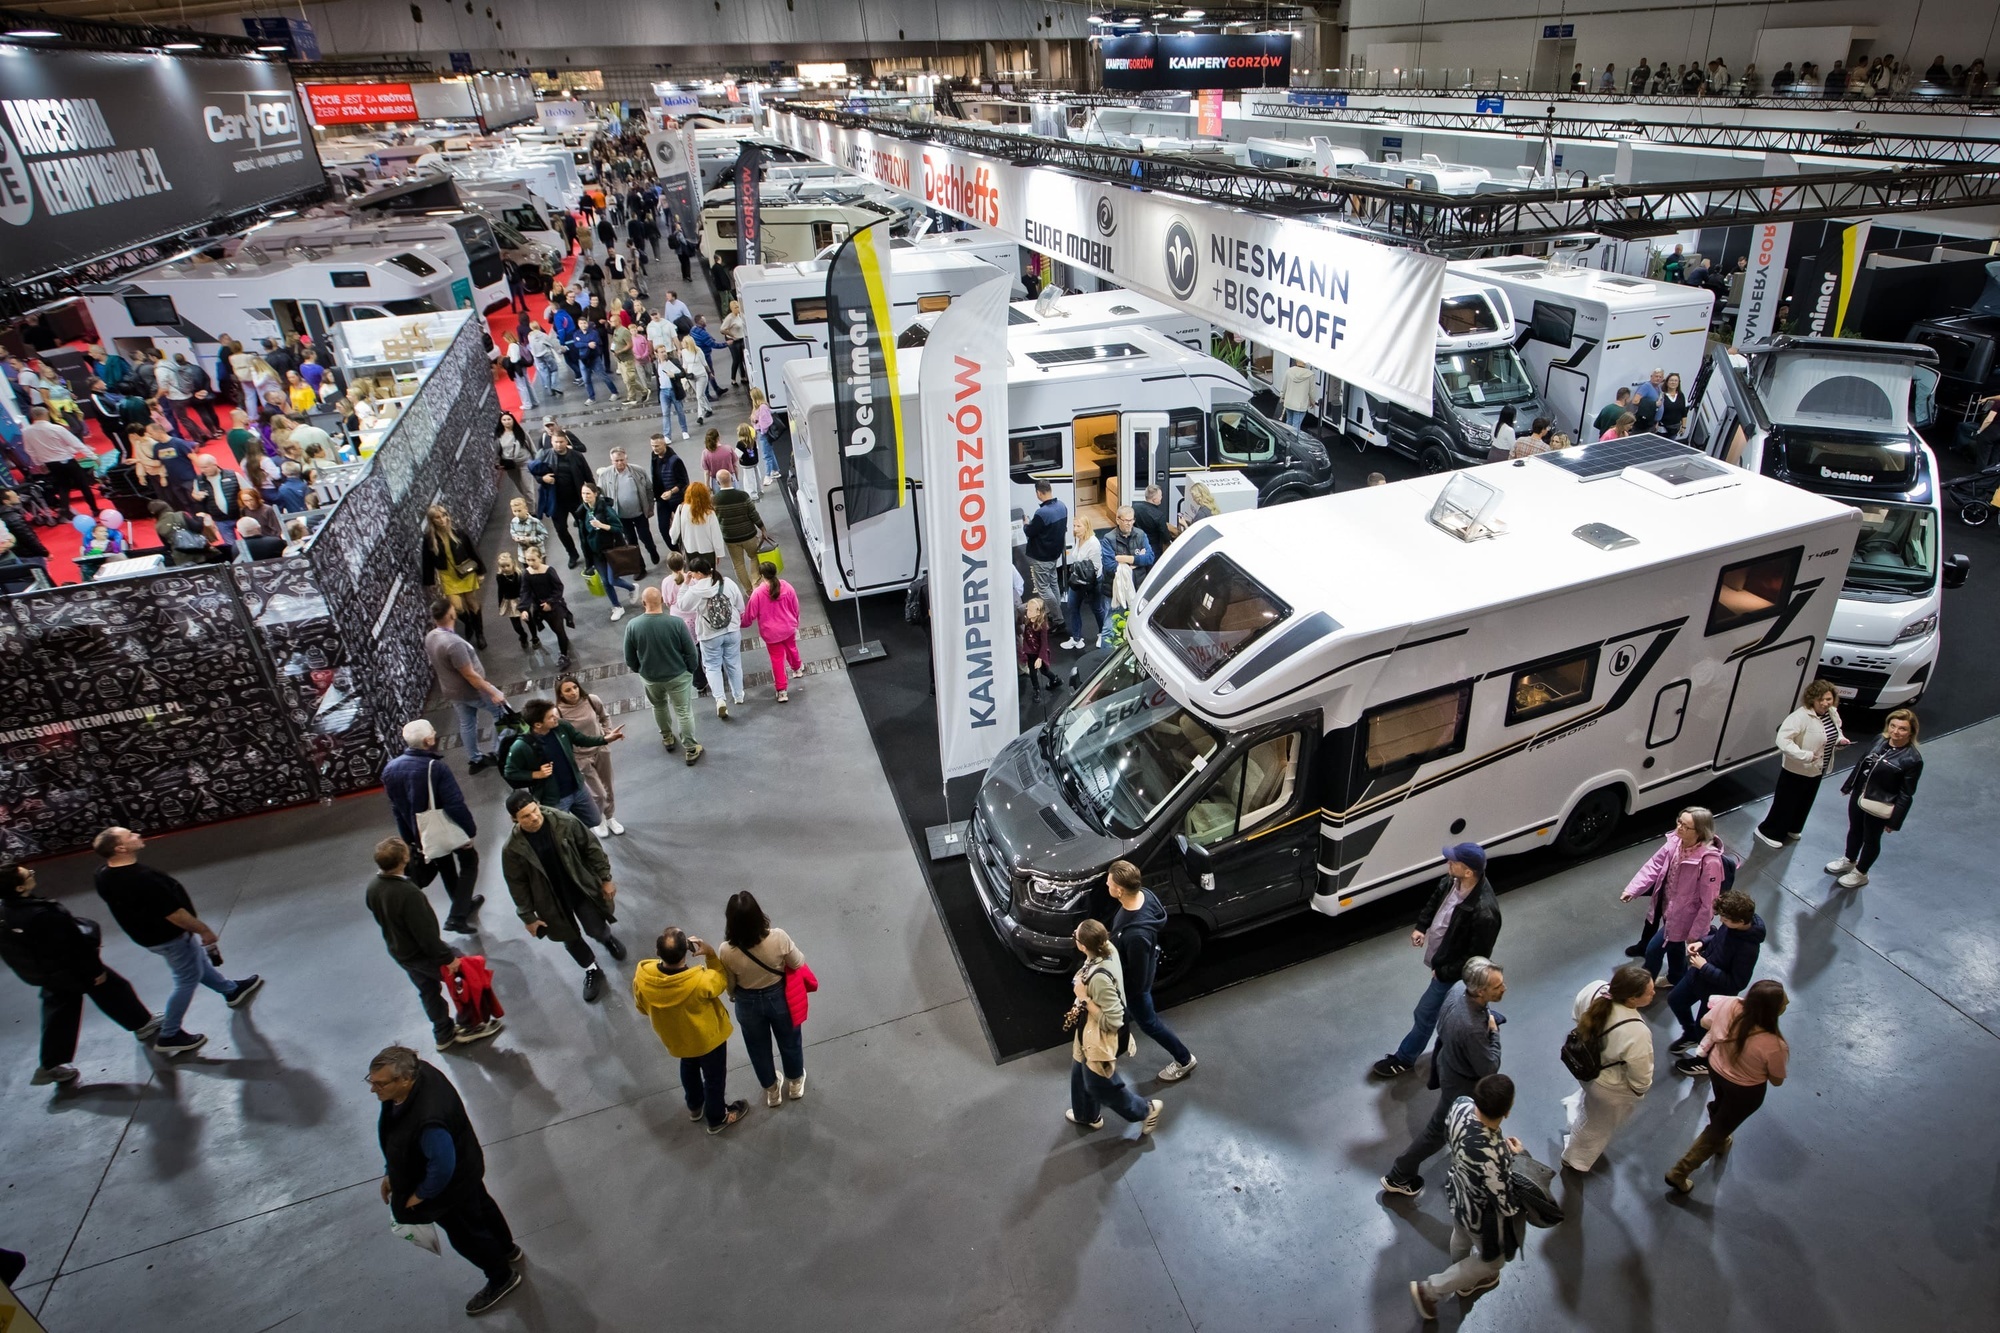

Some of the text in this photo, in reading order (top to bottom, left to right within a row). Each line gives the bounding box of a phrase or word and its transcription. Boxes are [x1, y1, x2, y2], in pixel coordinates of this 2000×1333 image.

[1105, 55, 1154, 70] KAMPERYGORZÓW
[1169, 53, 1282, 69] KAMPERYGORZÓW
[311, 92, 413, 105] ŻYCIE JEST ZA KRÓTKIE
[367, 107, 378, 115] W
[545, 106, 576, 118] Hobby
[2, 98, 116, 155] AKCESORIA
[28, 147, 173, 216] KEMPINGOWE.PL
[922, 153, 999, 228] Dethleffs
[1025, 218, 1115, 273] EURA MOBIL
[1211, 233, 1350, 305] NIESMANN
[845, 309, 876, 457] benimar
[1820, 466, 1874, 483] benimar
[947, 355, 998, 730] KAMPERYGORZÓW
[1142, 651, 1168, 689] benimar
[1527, 719, 1598, 753] TESSORO
